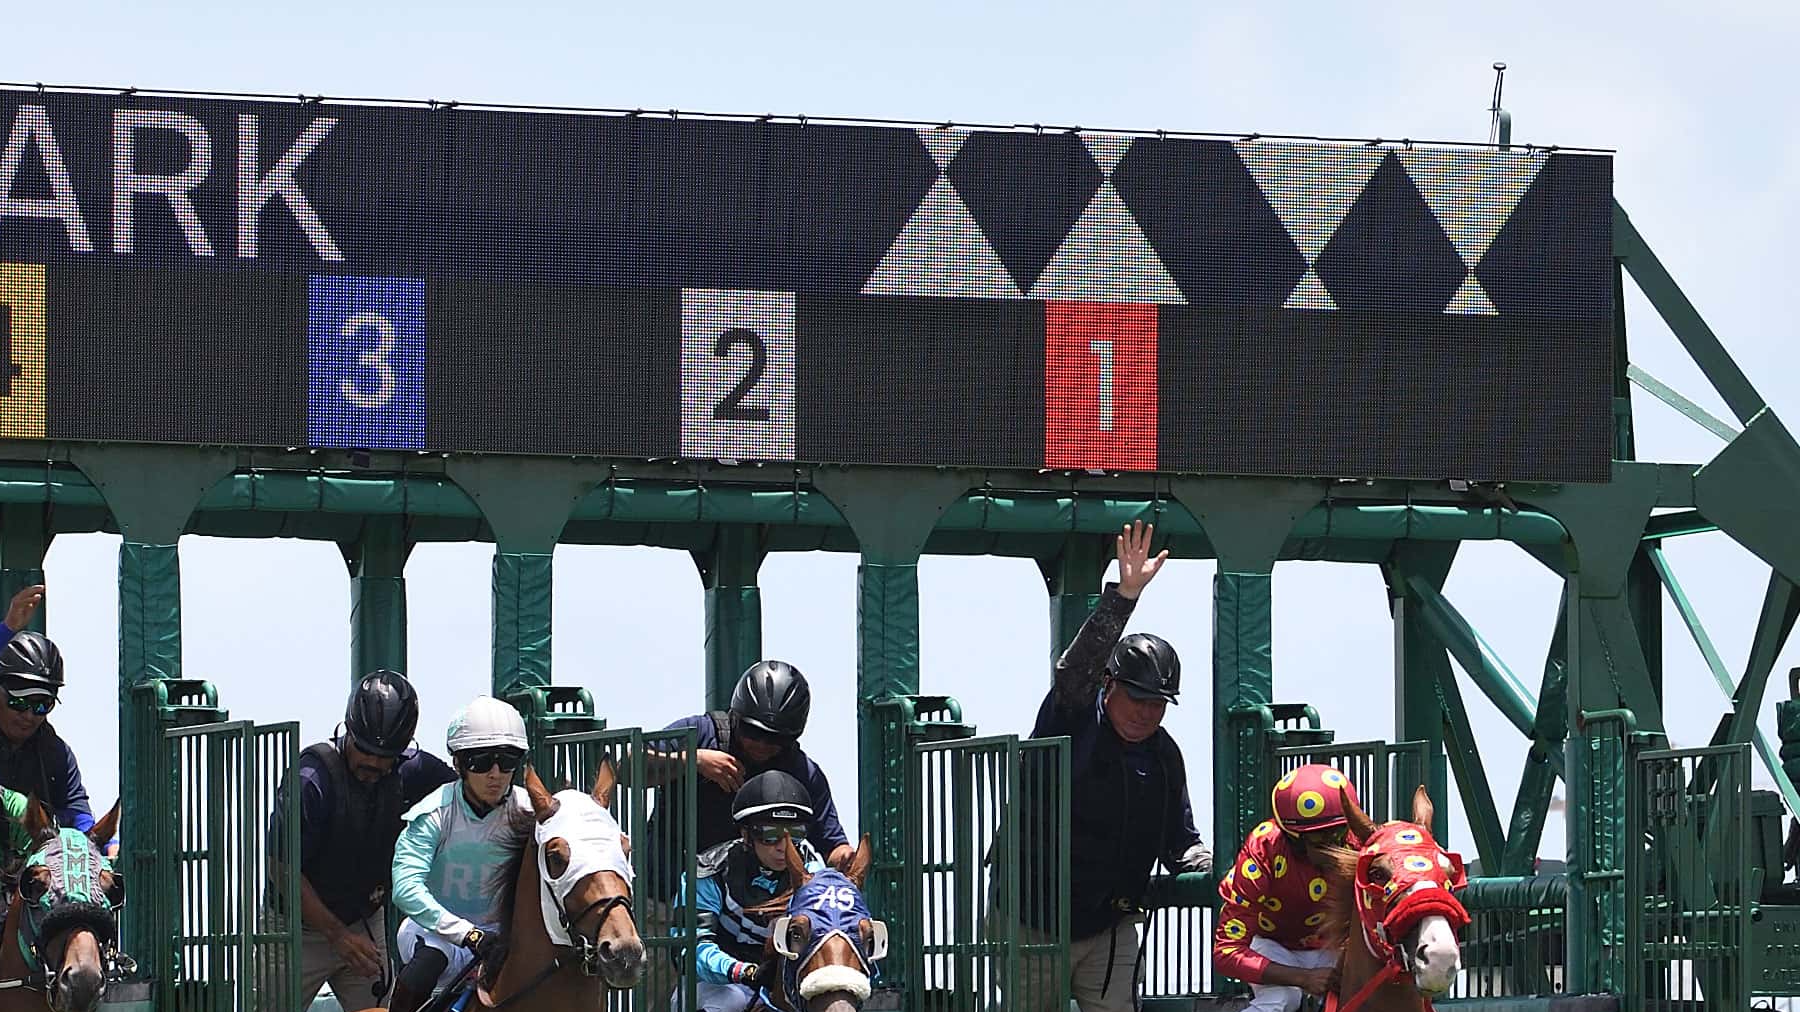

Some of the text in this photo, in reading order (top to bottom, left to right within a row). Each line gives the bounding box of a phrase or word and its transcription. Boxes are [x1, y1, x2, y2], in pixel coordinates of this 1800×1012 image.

[339, 310, 397, 408] 3
[710, 326, 771, 423] 2
[1087, 338, 1115, 433] 1
[67, 837, 88, 894] LMM
[812, 885, 856, 912] AS
